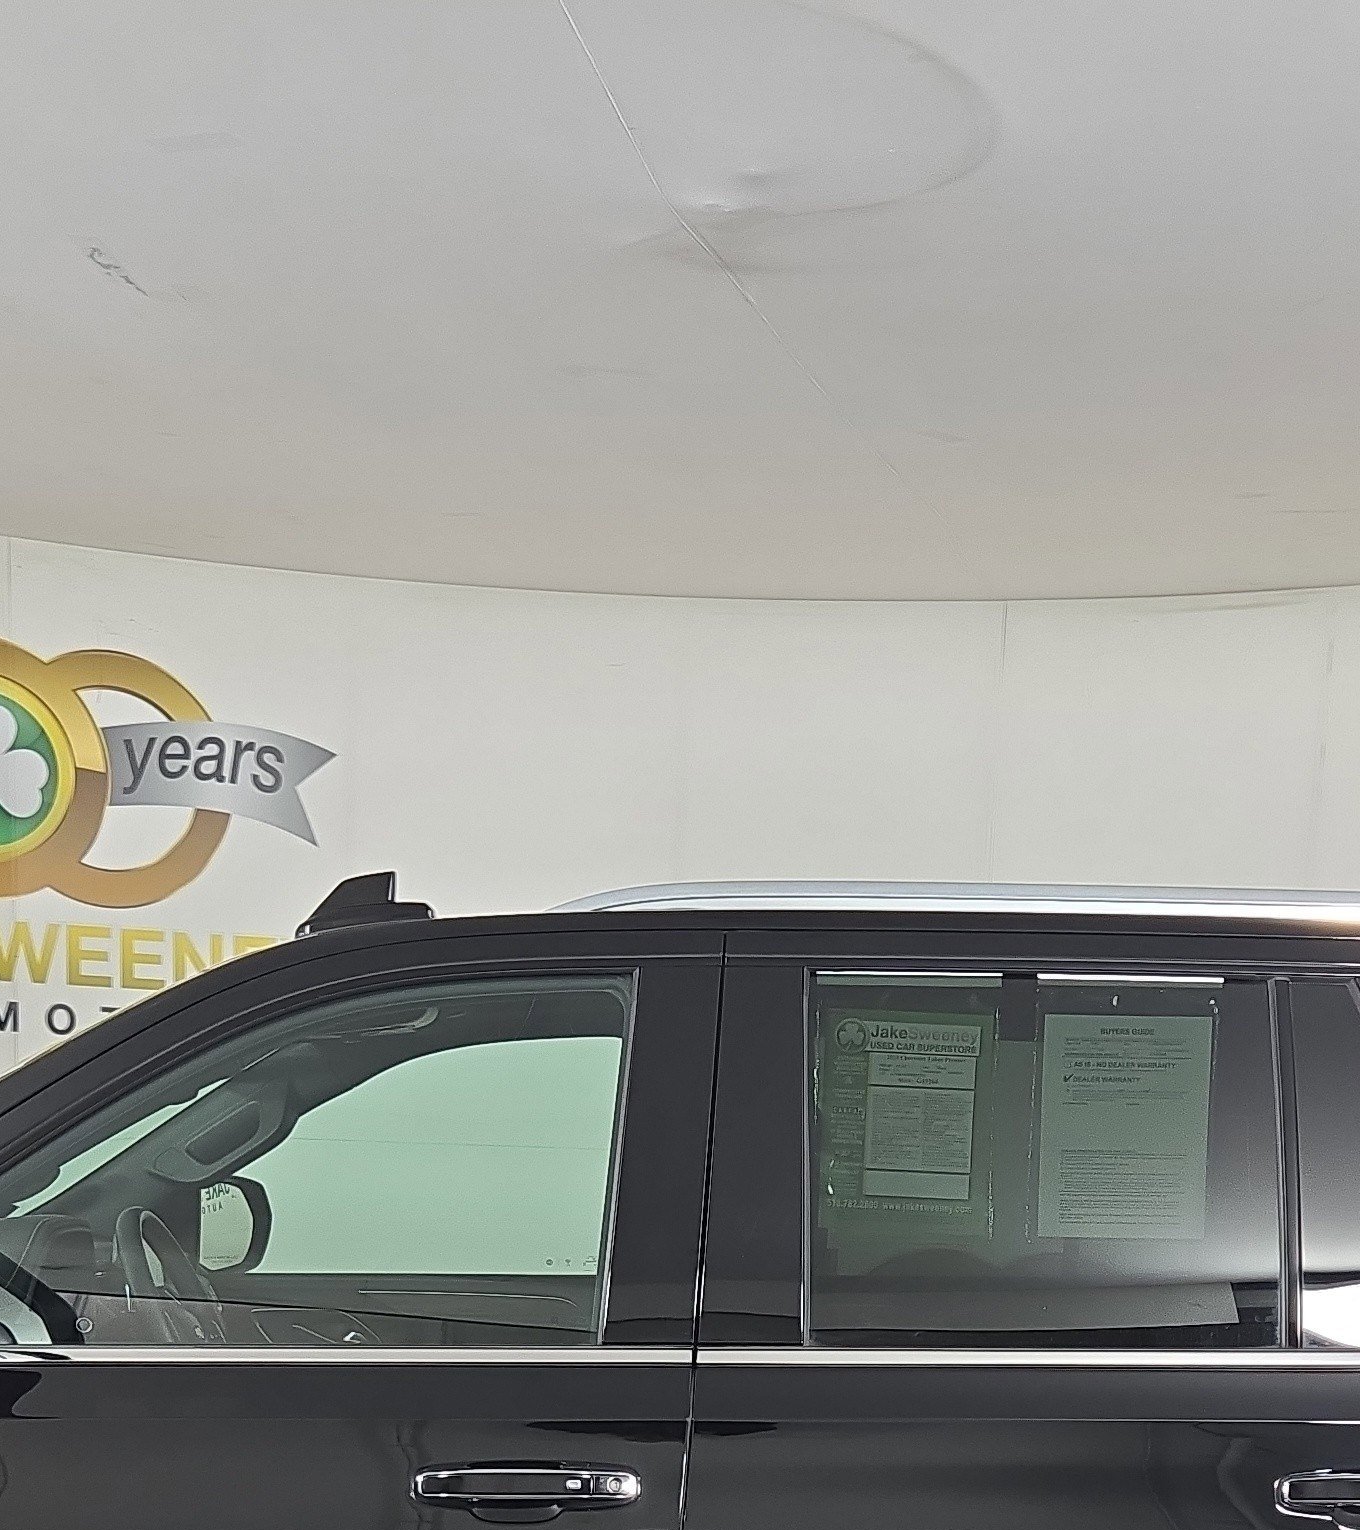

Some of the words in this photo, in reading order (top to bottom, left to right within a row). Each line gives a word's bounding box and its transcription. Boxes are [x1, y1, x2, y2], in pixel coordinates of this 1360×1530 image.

[122, 732, 286, 796] years
[870, 1042, 894, 1051] USED
[896, 1043, 915, 1052] CAR
[917, 1044, 977, 1054] SUPERSTORE
